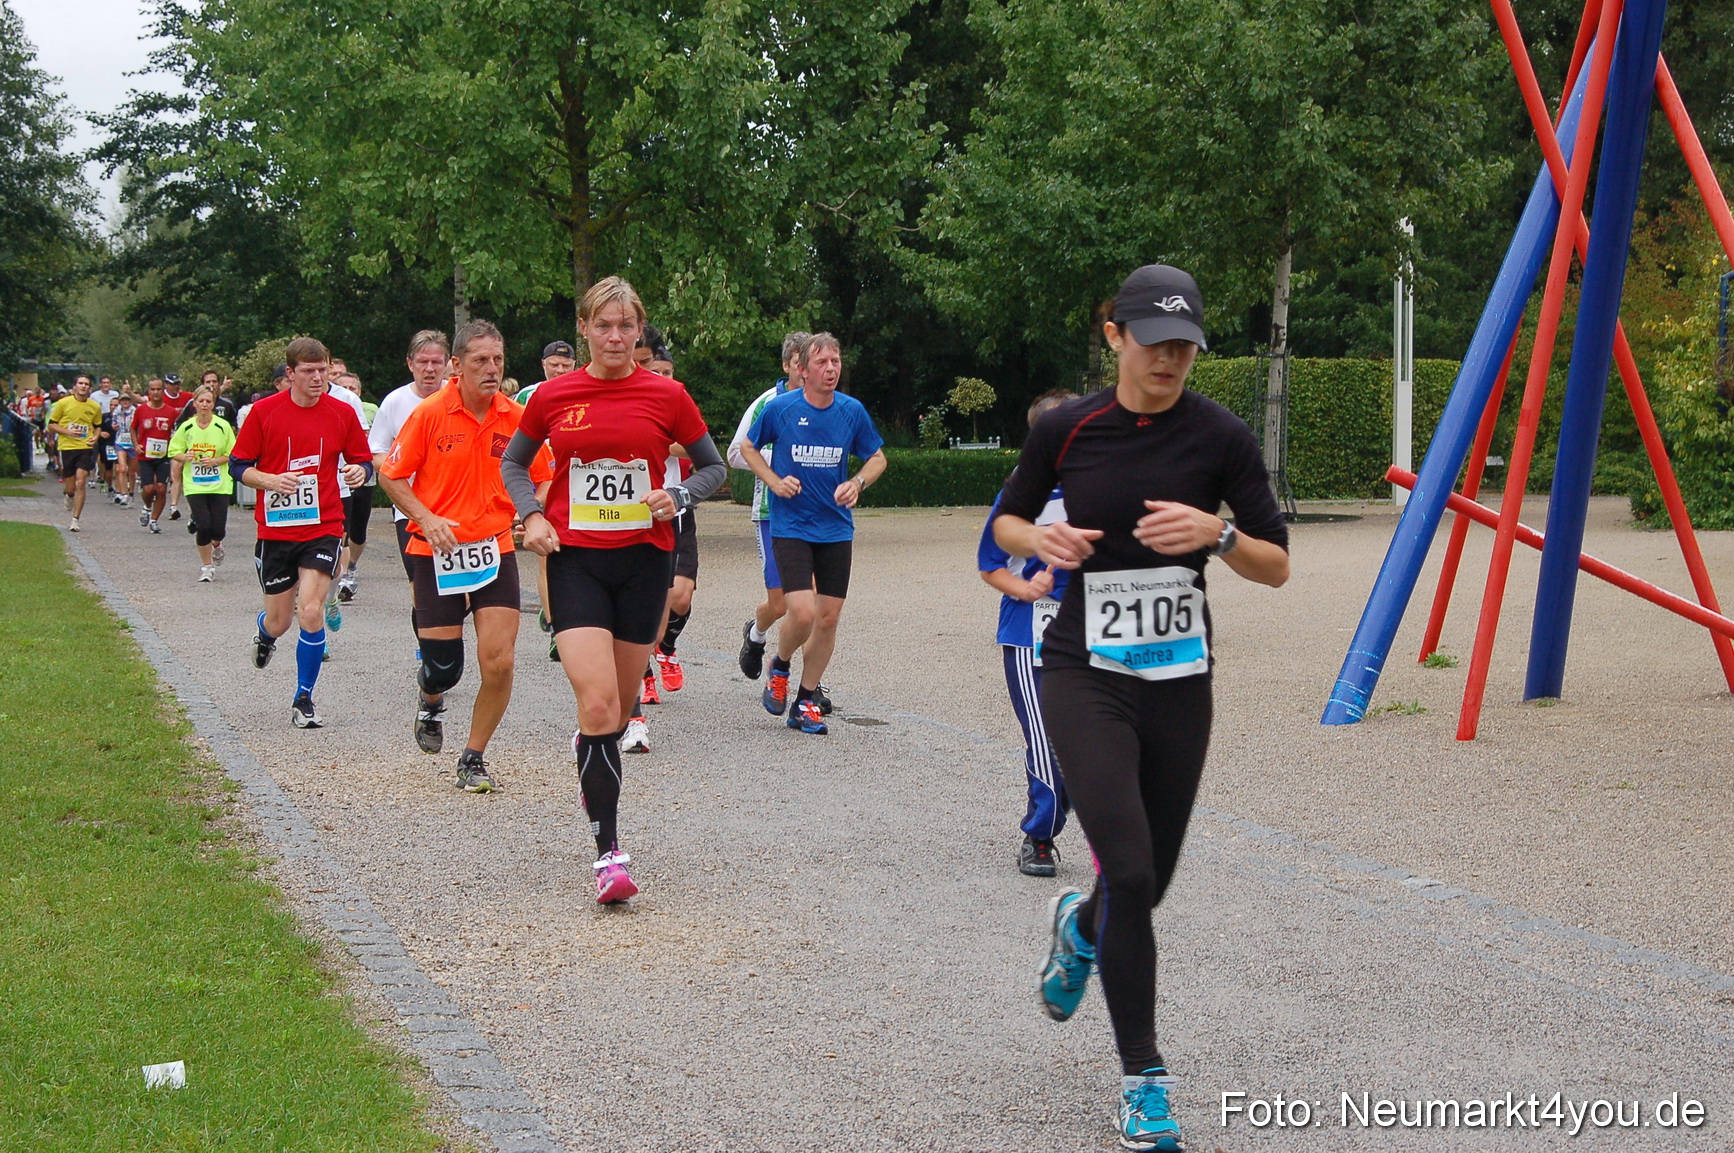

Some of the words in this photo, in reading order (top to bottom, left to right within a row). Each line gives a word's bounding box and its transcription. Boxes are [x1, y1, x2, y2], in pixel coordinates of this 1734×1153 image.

[152, 443, 162, 452] 12
[791, 444, 843, 458] HUBER
[194, 465, 219, 476] 2026
[585, 473, 635, 502] 264
[270, 487, 314, 509] 2315
[278, 511, 307, 520] Andreas
[598, 508, 620, 520] Rita
[316, 553, 333, 562] JAKO
[440, 545, 494, 572] 3156
[1035, 602, 1060, 611] PARTL
[1100, 593, 1193, 640] 2105
[1124, 648, 1175, 666] Andrea
